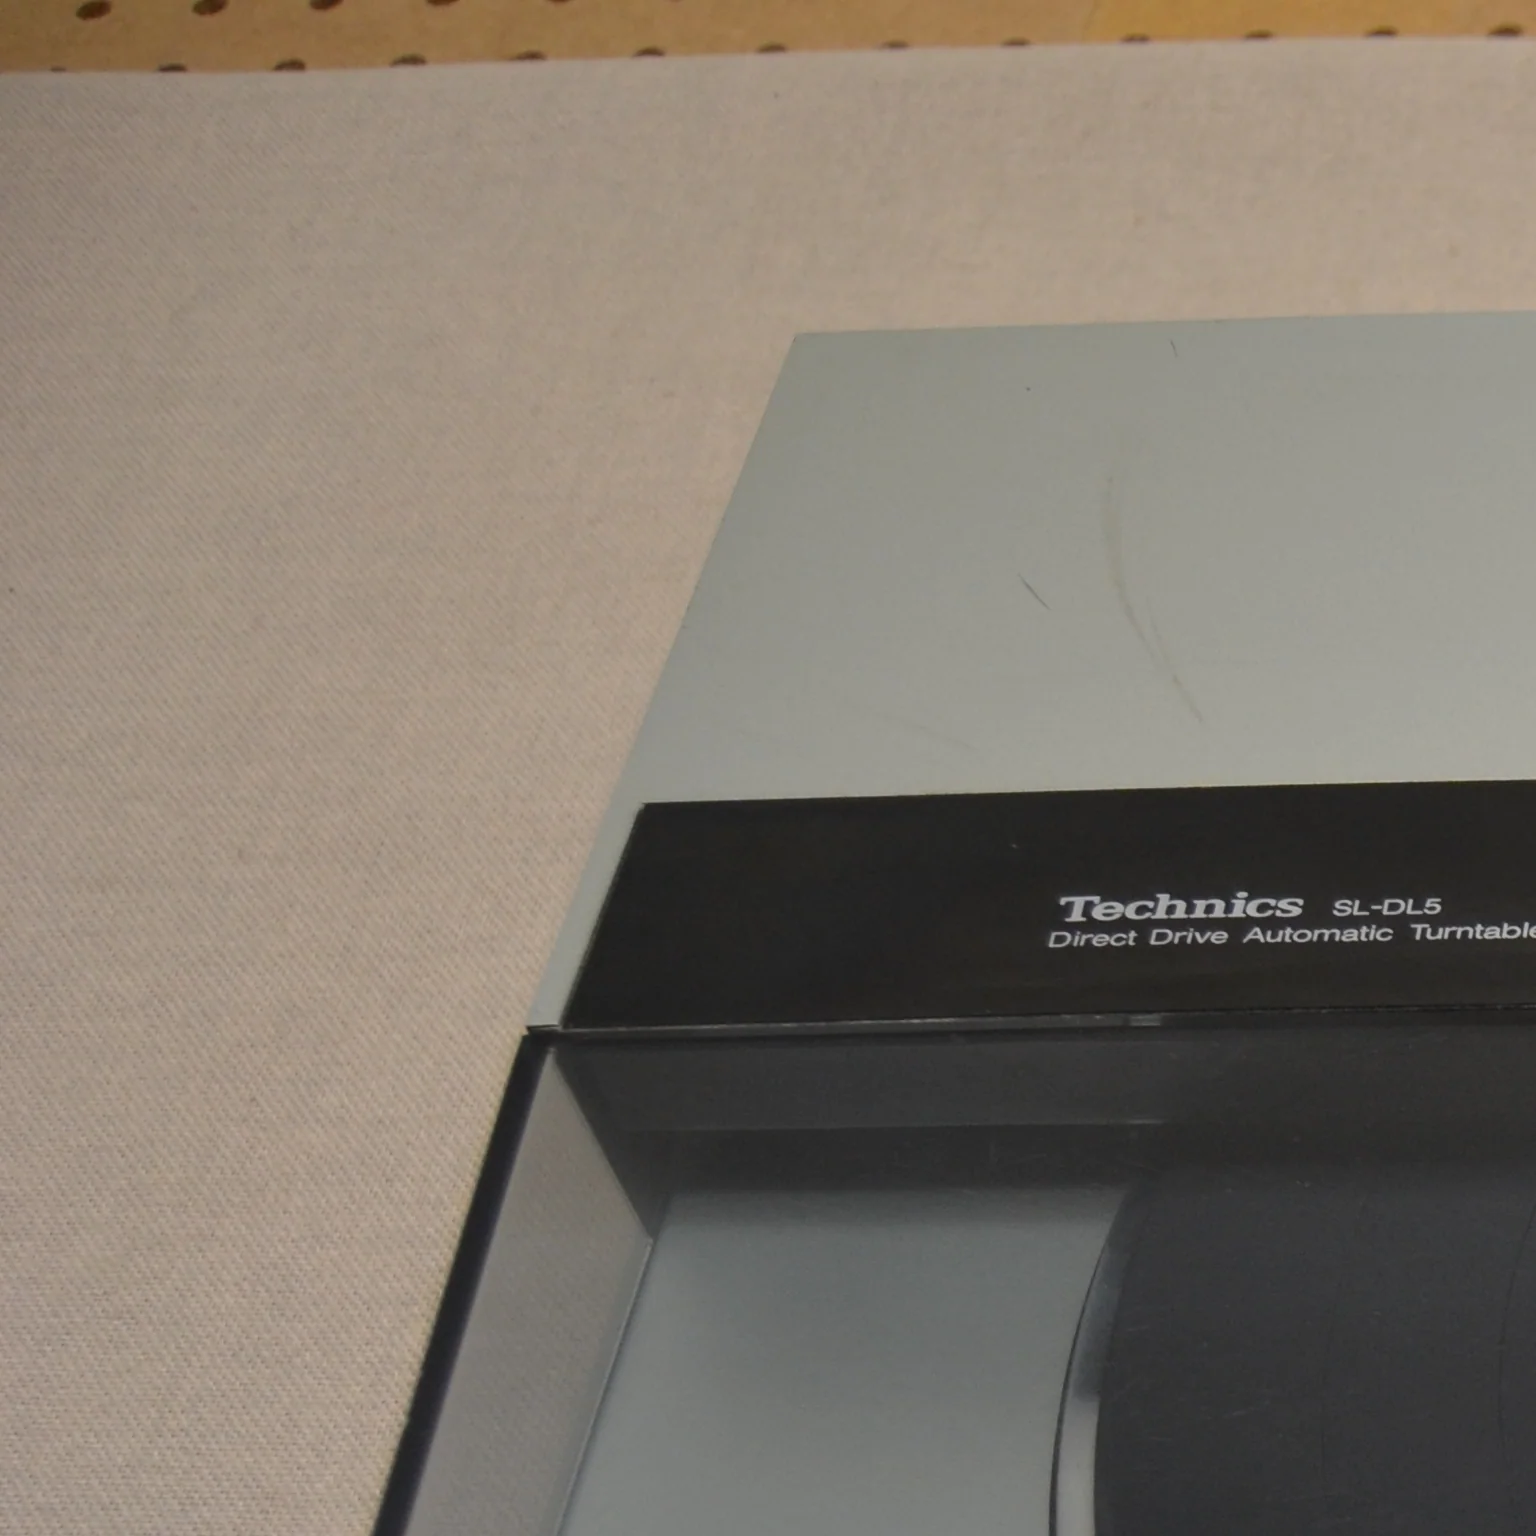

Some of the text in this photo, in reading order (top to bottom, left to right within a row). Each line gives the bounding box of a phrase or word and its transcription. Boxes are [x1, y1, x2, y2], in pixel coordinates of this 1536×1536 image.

[1059, 891, 1442, 923] Technics SL-DL5
[1048, 929, 1138, 948] Direct
[1150, 927, 1229, 946] Drive
[1242, 923, 1394, 944] Automatic
